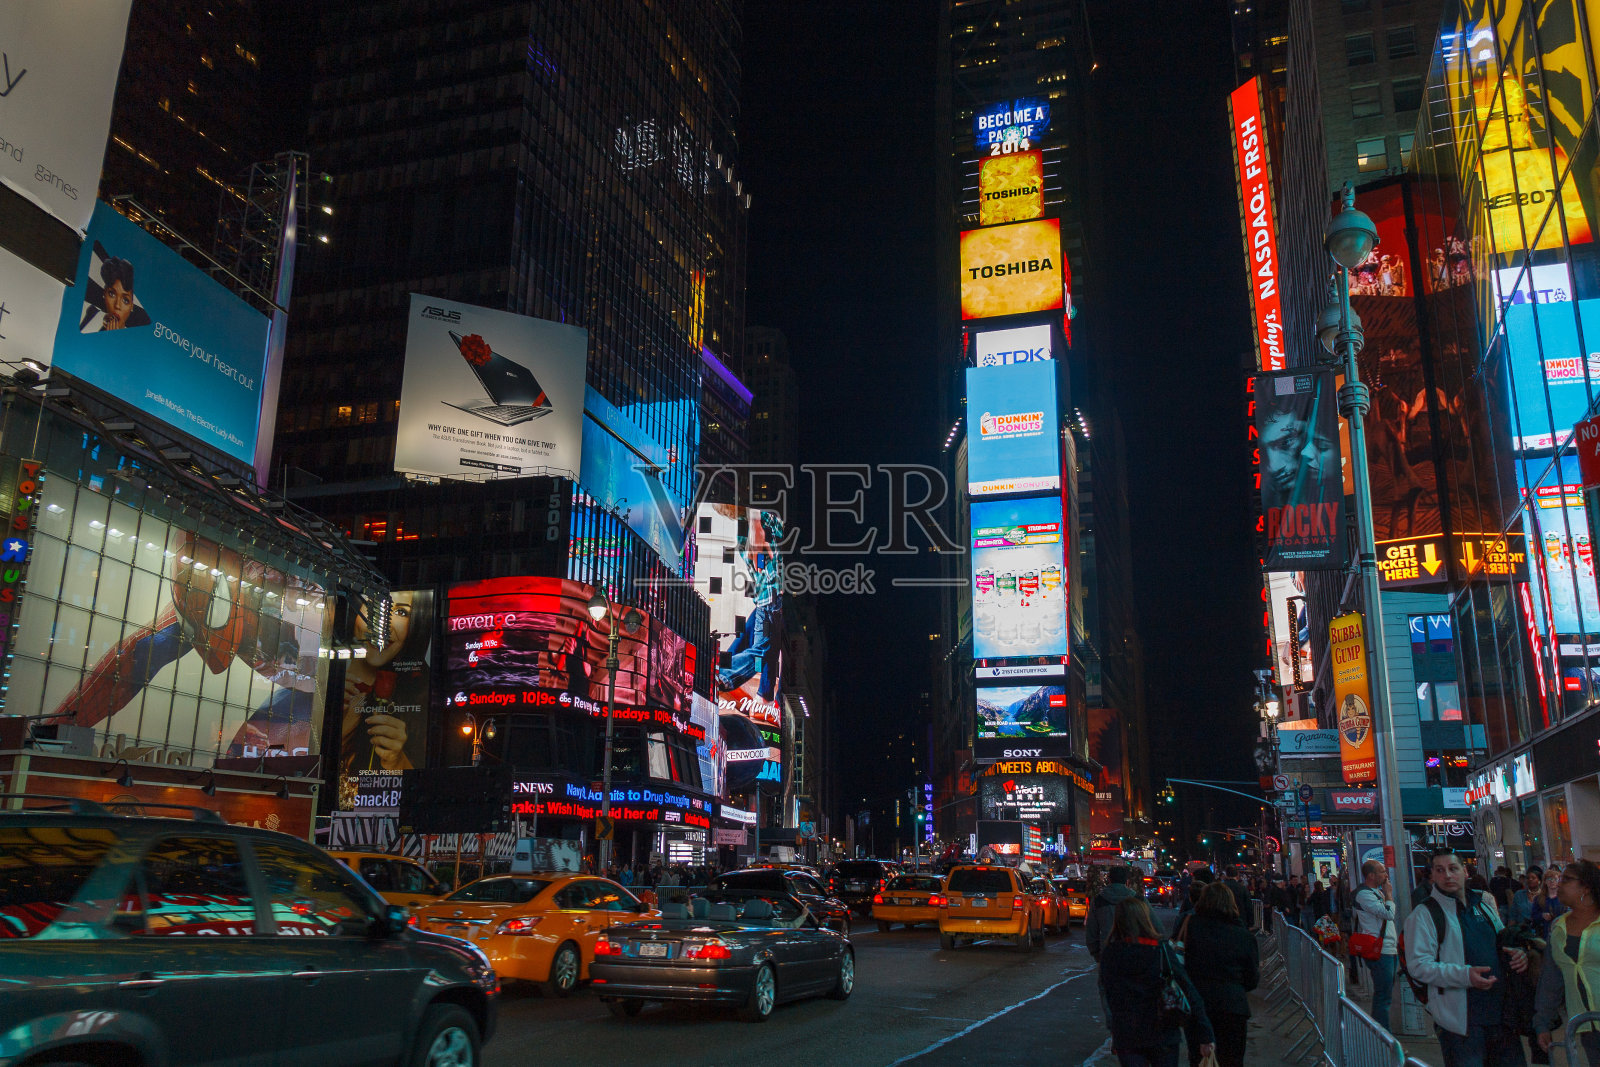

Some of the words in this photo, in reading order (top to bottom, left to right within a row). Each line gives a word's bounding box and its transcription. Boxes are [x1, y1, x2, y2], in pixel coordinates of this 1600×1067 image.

[979, 109, 1032, 130] BECOME
[1035, 106, 1044, 121] A
[990, 137, 1030, 156] 2014
[1240, 115, 1261, 180] FRSH
[34, 164, 79, 201] games
[984, 185, 1040, 202] TOSHIBA
[1250, 182, 1276, 300] NASDAQ:
[969, 258, 1054, 280] TOSHIBA
[422, 306, 462, 320] ASUS
[154, 322, 190, 352] groove
[189, 343, 213, 364] your
[213, 354, 238, 381] heart
[238, 373, 254, 391] out
[997, 347, 1044, 367] TDK
[997, 413, 1044, 425] DUNKIN'
[997, 421, 1041, 433] DONUTS
[428, 423, 441, 432] WHY
[442, 425, 456, 434] GIVE
[457, 428, 469, 436] ONE
[470, 430, 483, 438] GIFT
[484, 432, 501, 441] WHEN
[502, 435, 513, 443] YOU
[515, 437, 526, 445] CAN
[527, 439, 540, 447] GIVE
[541, 441, 556, 450] TWO?
[1581, 424, 1599, 441] NO
[982, 483, 1016, 492] DUNKIN'
[1017, 480, 1050, 490] DONUTS
[546, 477, 560, 542] 1500
[1267, 501, 1339, 539] ROCKY
[1268, 537, 1337, 547] BROADWAY
[1386, 544, 1417, 560] GET
[1384, 568, 1420, 582] HERE
[451, 613, 517, 639] revenge
[1330, 623, 1362, 646] BUBBA
[465, 641, 483, 650] Sundays
[1334, 644, 1361, 665] GUMP
[1336, 673, 1365, 685] COMPANY
[1338, 666, 1361, 677] SHRIMP
[354, 702, 422, 714] BACHELORETTE
[455, 691, 467, 703] abc
[469, 691, 516, 706] Sundays
[559, 692, 572, 704] abc
[602, 707, 650, 722] Sndays
[1003, 749, 1042, 758] SONY
[996, 761, 1032, 774] TWEETS
[1342, 761, 1375, 772] RESTAURANT
[373, 776, 391, 788] HOT
[1348, 771, 1371, 780] MARKET
[519, 782, 554, 794] NEWS
[627, 789, 641, 801] to
[643, 789, 664, 806] Drug
[547, 801, 572, 815] Wish
[623, 807, 646, 820] her
[646, 808, 659, 821] off
